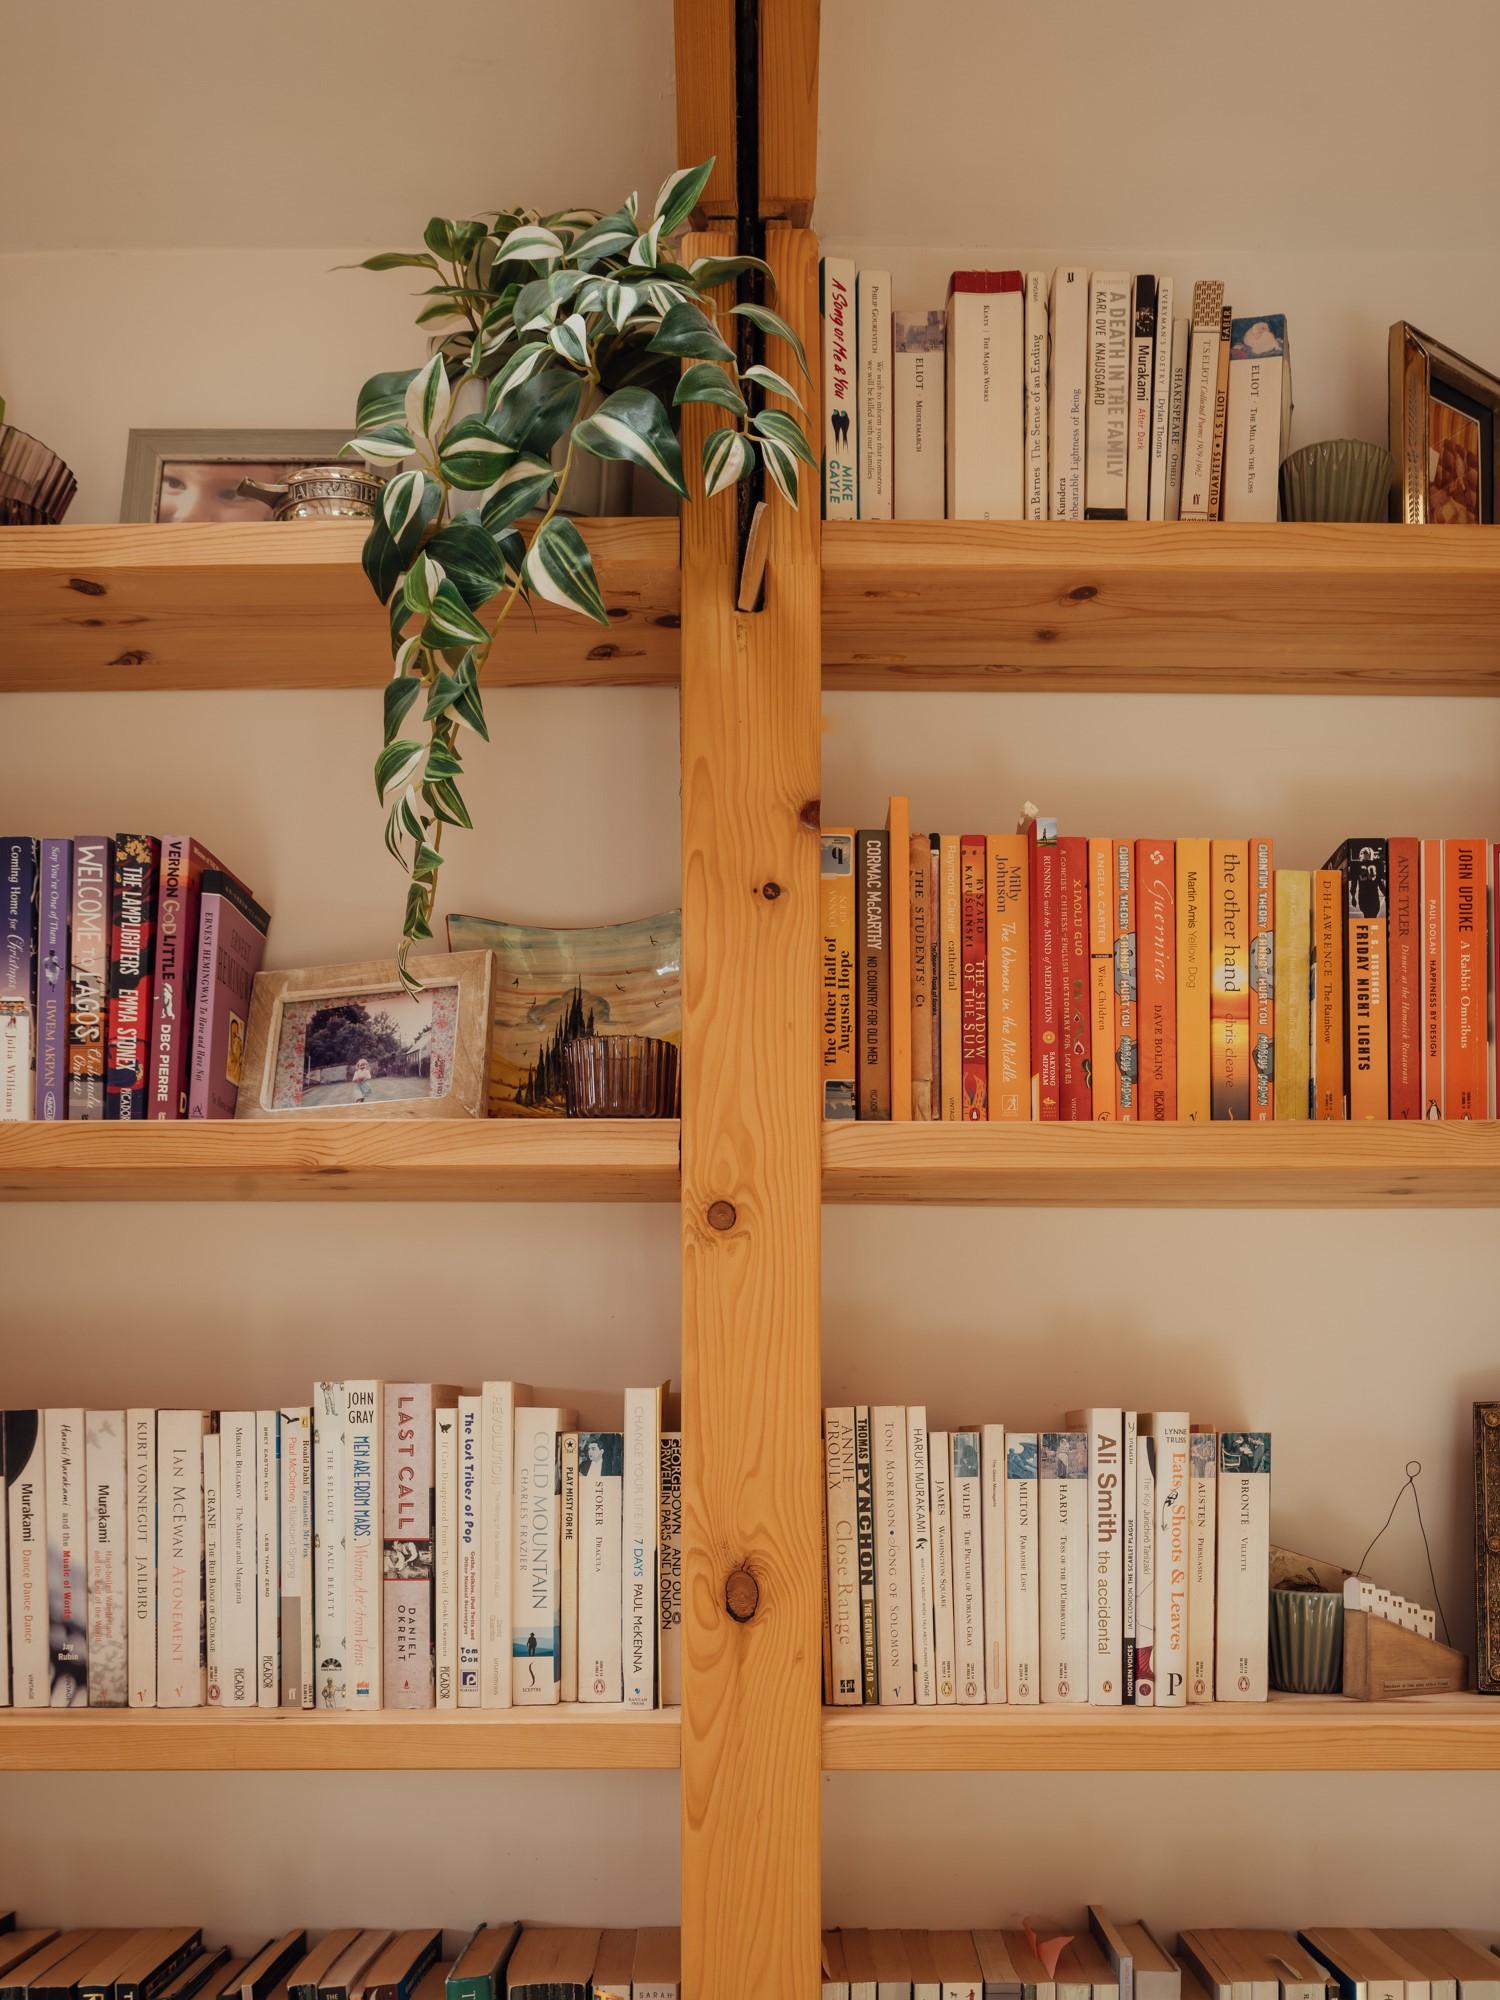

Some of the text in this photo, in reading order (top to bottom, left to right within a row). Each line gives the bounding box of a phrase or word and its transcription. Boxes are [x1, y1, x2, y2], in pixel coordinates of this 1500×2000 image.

[830, 293, 847, 326] Song
[833, 279, 847, 291] A
[833, 342, 847, 360] Me
[1094, 292, 1106, 405] KARL OVE KNAUSGAARD
[1222, 310, 1231, 341] FABER
[834, 376, 848, 399] You
[916, 358, 924, 389] ELIOT
[1107, 292, 1126, 477] A DEATH IN THE FAMILY
[1137, 345, 1149, 449] Murakami After Dark
[1250, 365, 1260, 397] ELIOT
[1156, 398, 1165, 458] Dylan Thomas
[1172, 367, 1183, 444] SHAKESPEARE
[829, 460, 840, 503] GAYLE
[842, 466, 853, 501] MIKE
[49, 846, 60, 944] Say You're One of Them
[77, 846, 104, 941] WELCOME
[167, 842, 182, 898] VERNON
[995, 855, 1009, 913] Johnson
[1008, 867, 1021, 901] Milly
[1187, 871, 1197, 928] Martin Amis
[1398, 855, 1409, 936] ANNE TYLER
[6, 846, 24, 989] Coming Home for Christmas
[1224, 854, 1240, 992] the other hand
[116, 867, 142, 1071] THE LAMPLIGHTERS EMMA STONEX
[199, 912, 213, 1004] ERNEST HEMINGWAY
[867, 840, 881, 1064] CORMAC McCARTHY NO COUNTRY FOR OLD MEN
[948, 940, 957, 991] cathedral
[1458, 848, 1473, 1048] JOHN UPDIKE A Rabbit Omnibus
[75, 972, 100, 1039] LAGOS
[824, 937, 837, 1066] The Other Half of
[839, 950, 850, 1053] Augusta Hope
[964, 963, 975, 1058] OF THE SUN
[975, 961, 985, 1058] THE SHADOW
[1356, 925, 1370, 1071] FRIDAY NIGHT LIGHTS
[1429, 1011, 1436, 1021] BY
[44, 999, 56, 1086] UWEM AKPAN
[157, 1024, 171, 1101] DBC PIERRE
[1153, 1005, 1164, 1080] DAVE BOLING
[1225, 1013, 1236, 1087] chris cleave
[5, 1033, 16, 1113] Julia Williams
[348, 1393, 374, 1409] JOHN
[349, 1410, 374, 1424] GRAY
[464, 1413, 474, 1434] The
[398, 1397, 414, 1529] LAST CALL
[464, 1465, 474, 1500] Tribes
[828, 1420, 840, 1489] PROULX
[841, 1426, 854, 1483] ANNIE
[913, 1428, 926, 1533] HARUKI MURAKAMI
[22, 1483, 34, 1542] Murakami
[97, 1485, 110, 1543] Murakami
[136, 1422, 148, 1619] KURT VONNEGUT JAILBIRD
[464, 1505, 474, 1517] of
[520, 1468, 528, 1571] CHARLES FRAZIER
[532, 1432, 549, 1609] COLD MOUNTAIN
[595, 1481, 604, 1526] STOKER
[857, 1419, 873, 1585] THOMAS PYNCHON
[936, 1480, 945, 1515] JAMES
[962, 1483, 971, 1519] WILDE
[1020, 1481, 1028, 1526] MILTON
[1059, 1484, 1068, 1525] HARDY
[1198, 1482, 1206, 1527] AUSTEN
[463, 1521, 474, 1543] Pop
[566, 1529, 573, 1540] ME
[1098, 1434, 1116, 1654] Ali Smith the accidental
[634, 1549, 643, 1576] DAYS
[835, 1520, 853, 1645] Close Range
[1170, 1505, 1186, 1650] Shoots & Leaves
[633, 1584, 643, 1612] PAUL
[398, 1605, 406, 1661] OKRENT
[408, 1608, 416, 1659] DANIEL
[633, 1615, 643, 1673] McKENNA
